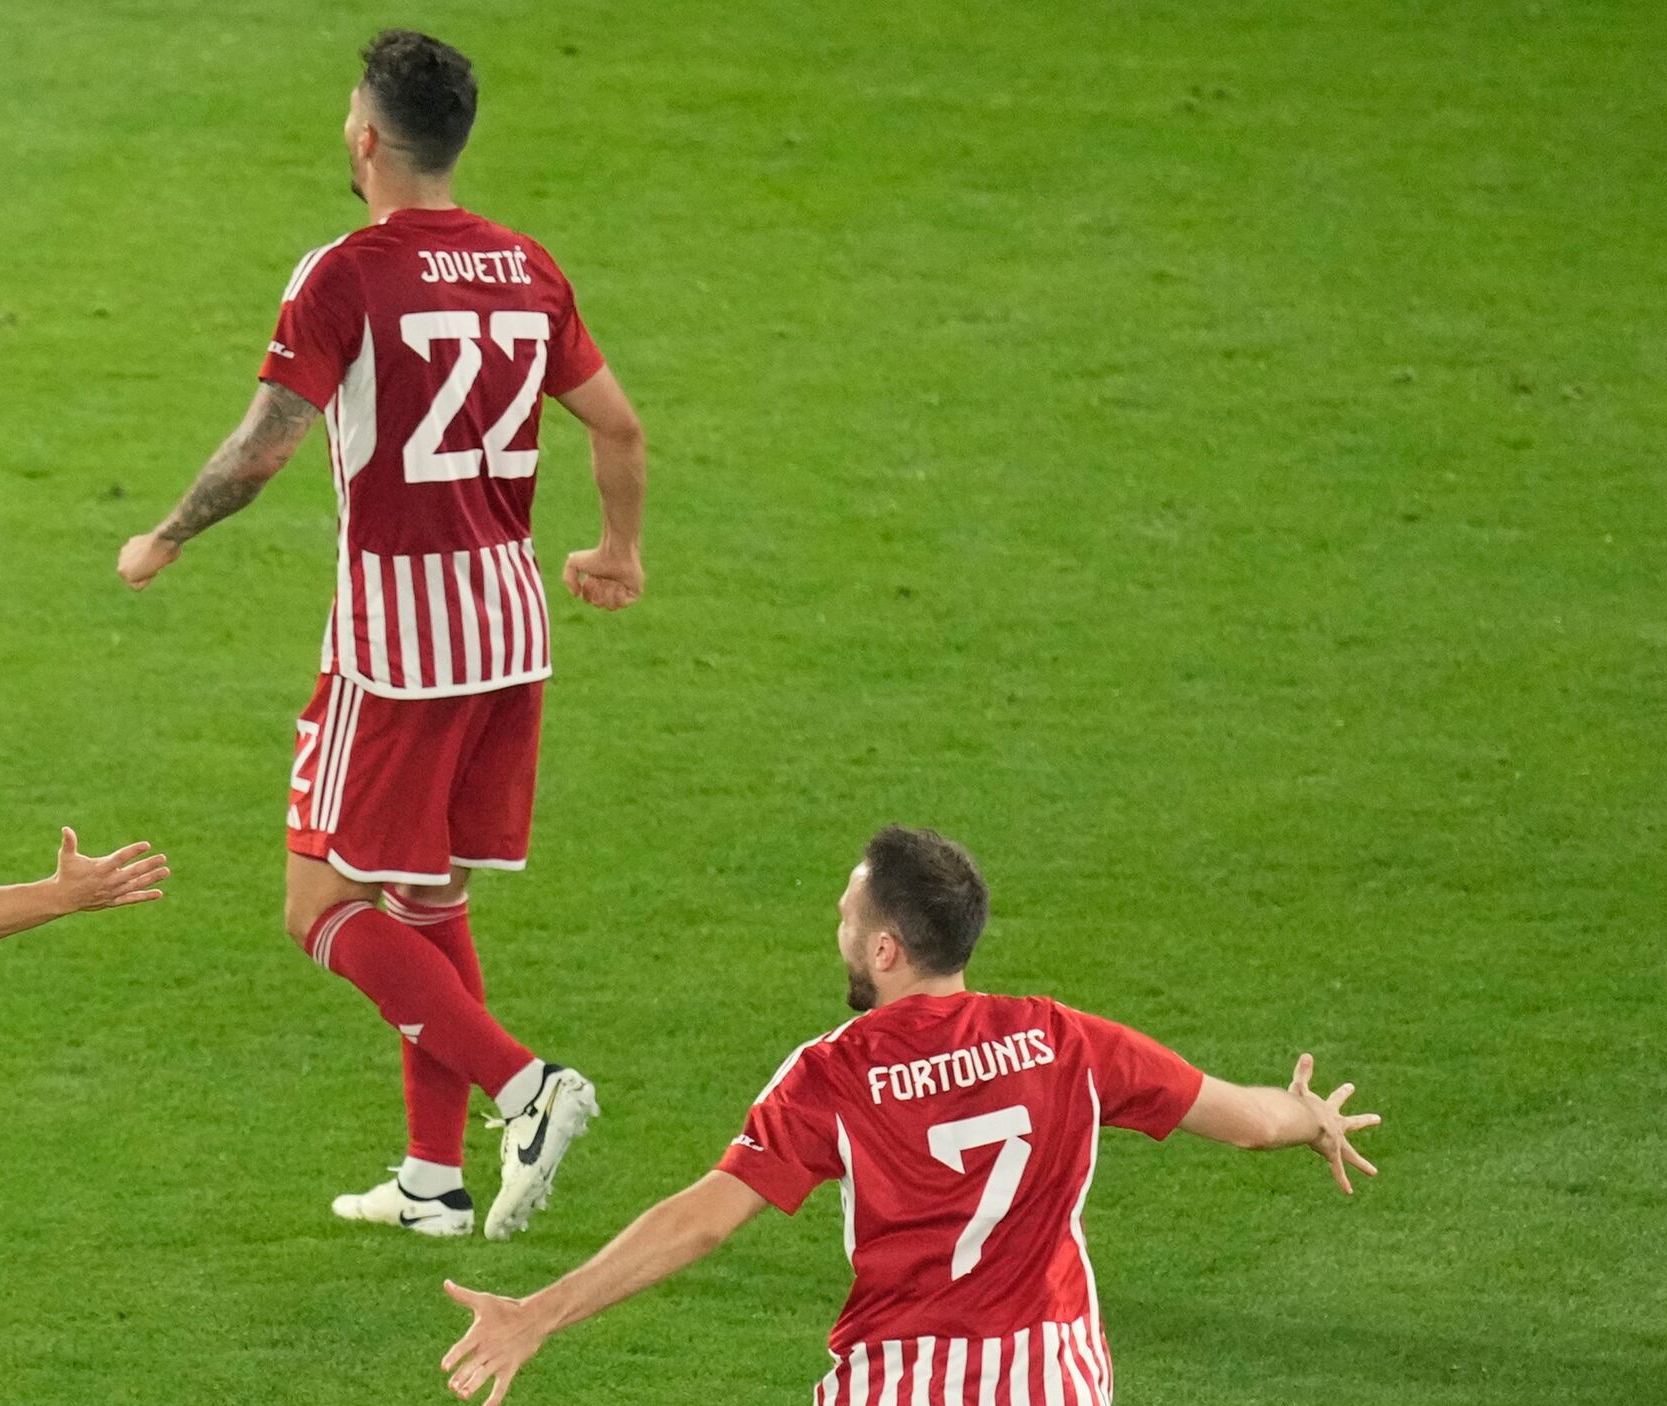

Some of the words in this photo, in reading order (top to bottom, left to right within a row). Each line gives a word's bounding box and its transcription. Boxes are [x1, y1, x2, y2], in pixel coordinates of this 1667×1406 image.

[399, 310, 550, 484] 22
[866, 1028, 1055, 1104] FORTOUNIS
[927, 1104, 1033, 1281] 7
